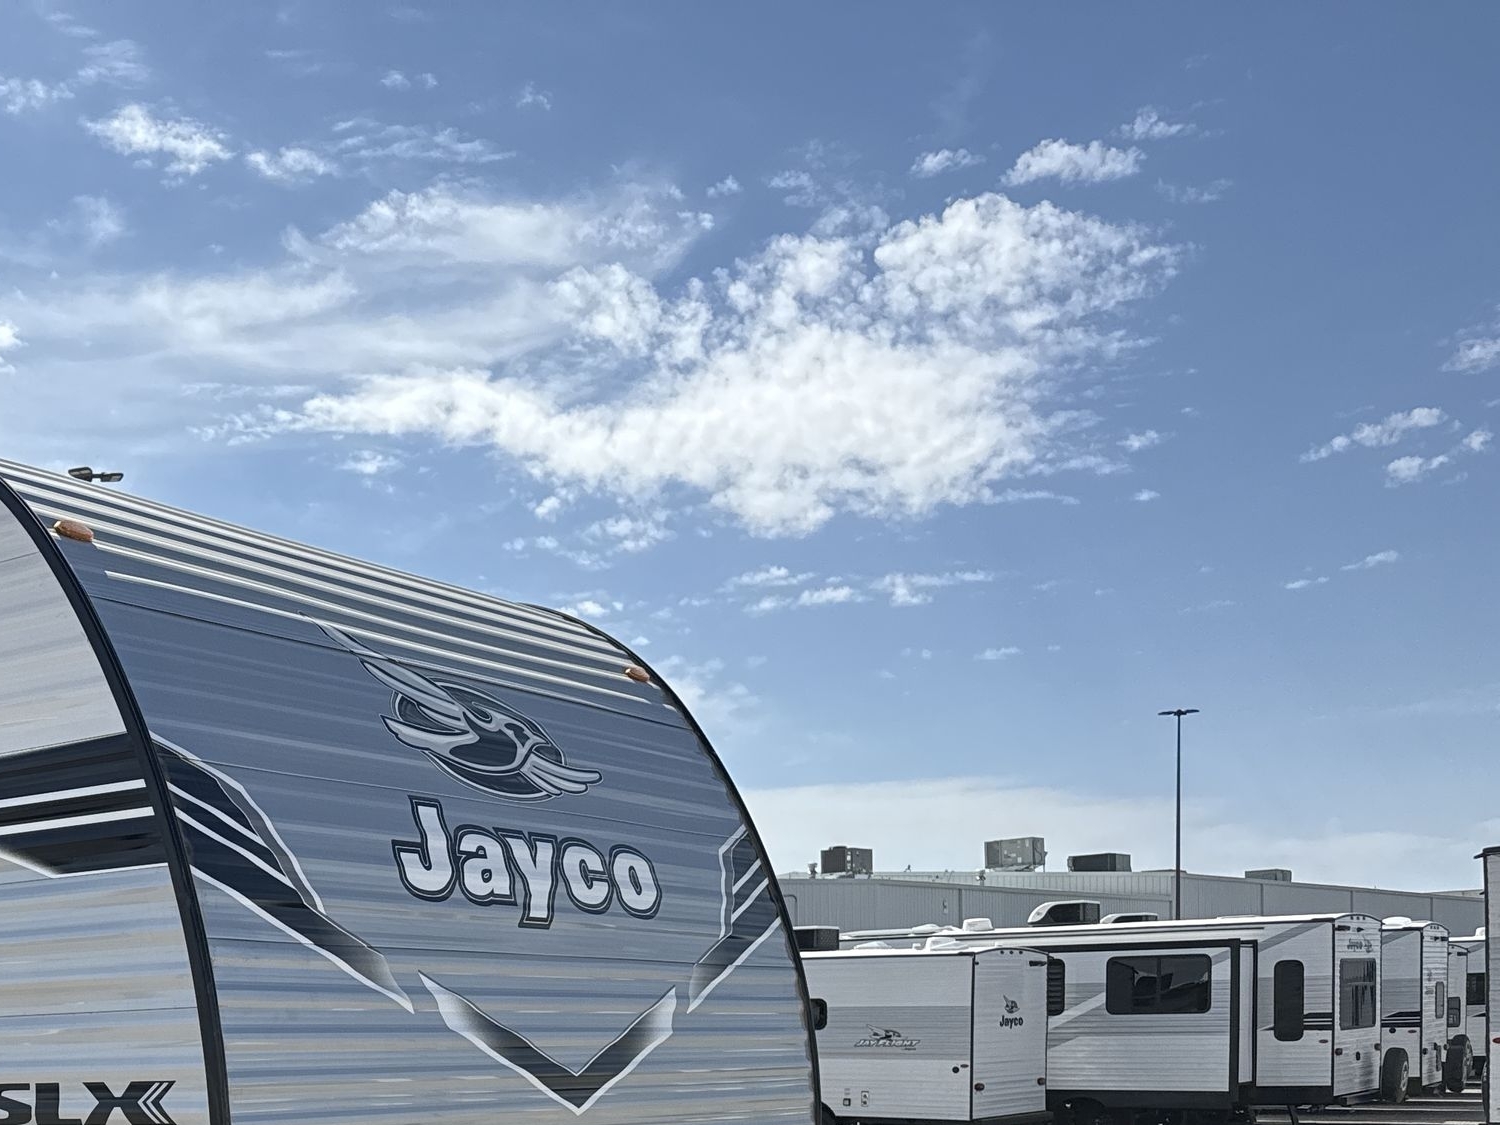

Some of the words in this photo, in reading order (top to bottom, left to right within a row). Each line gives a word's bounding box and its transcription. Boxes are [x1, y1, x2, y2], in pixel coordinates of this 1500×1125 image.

[391, 795, 662, 930] Jayco
[999, 1015, 1024, 1029] Jayco
[854, 1039, 879, 1048] JAY
[877, 1039, 921, 1048] FLIGHT
